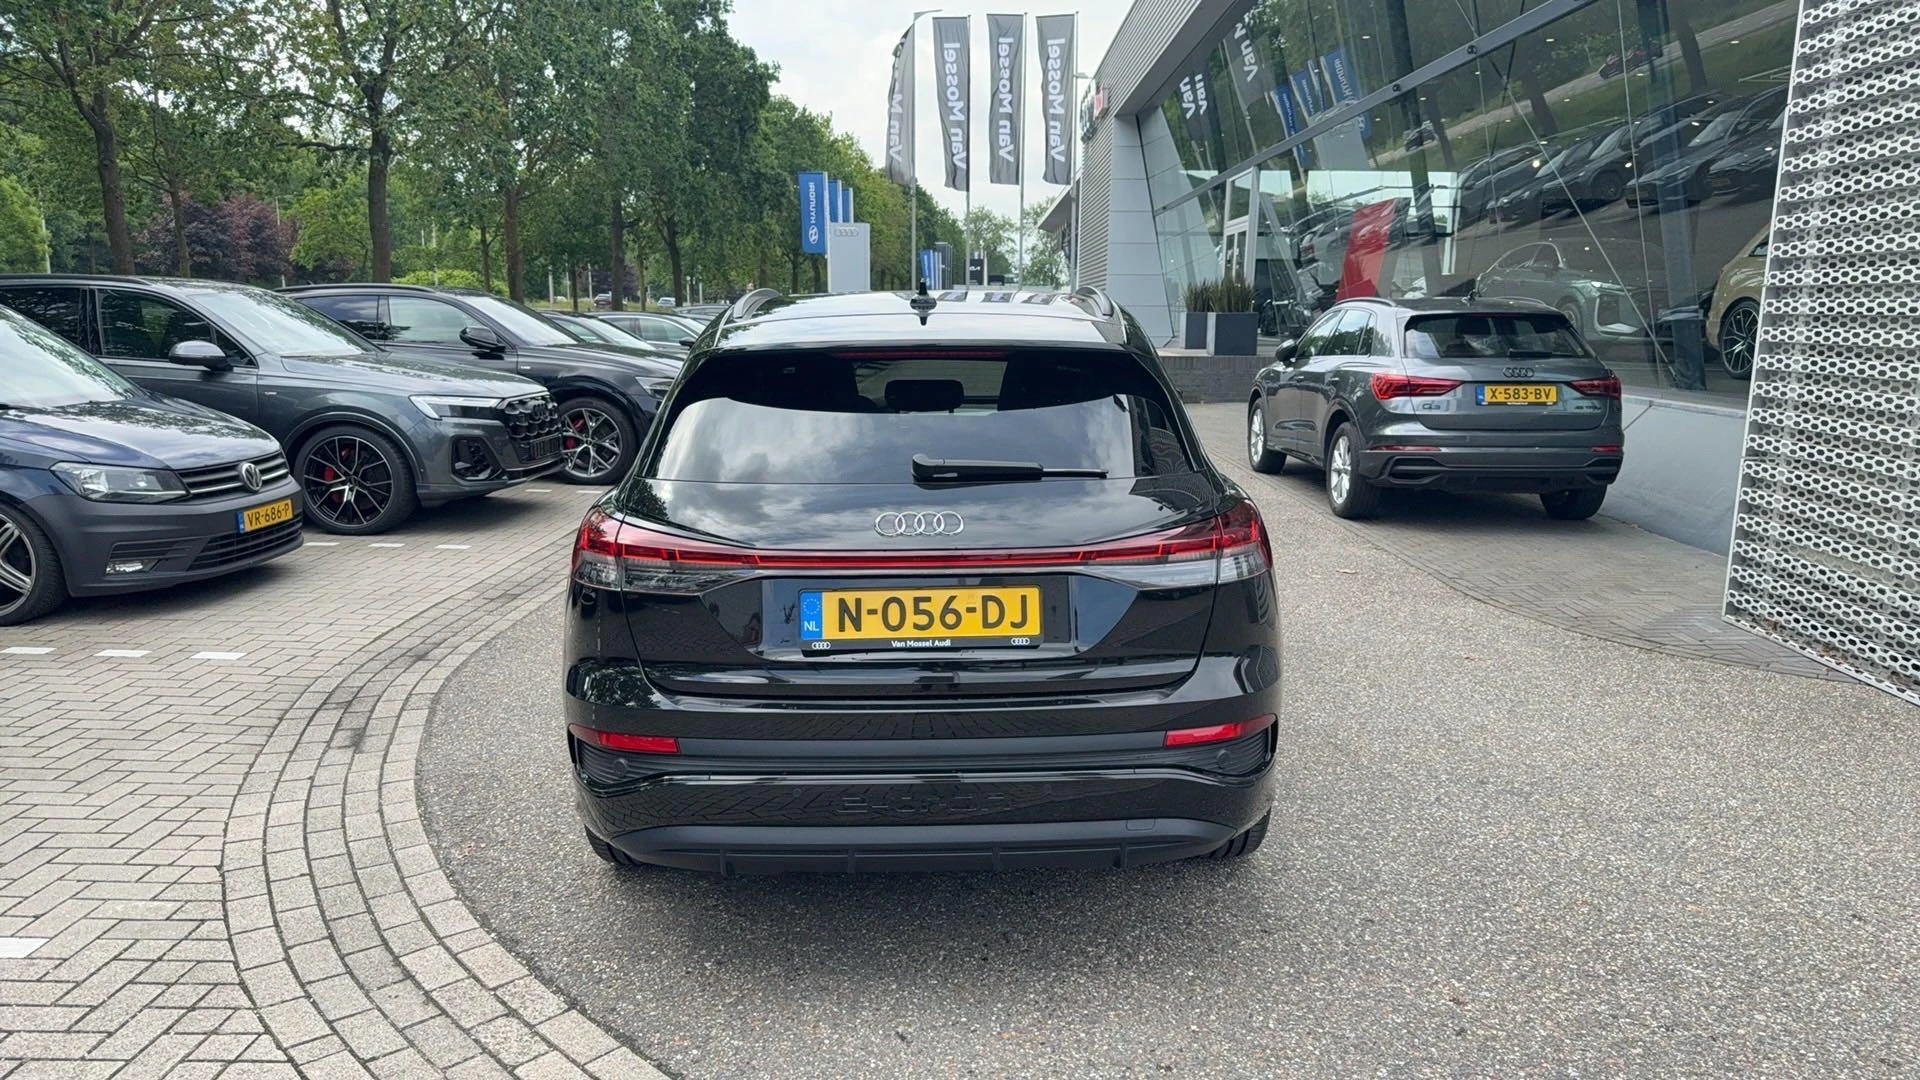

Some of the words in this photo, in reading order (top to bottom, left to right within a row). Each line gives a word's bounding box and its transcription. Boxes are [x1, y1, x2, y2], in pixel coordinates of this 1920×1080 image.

[1240, 39, 1258, 82] Van
[1335, 58, 1353, 97] HYUNDAI
[1180, 76, 1196, 119] Van
[1490, 388, 1551, 400] X-583-BV
[247, 502, 290, 528] VR-686-P
[803, 620, 820, 631] NL
[838, 594, 1028, 632] N-056-DJ
[891, 640, 906, 648] Van
[906, 640, 932, 648] Mossel
[934, 639, 951, 647] Audi
